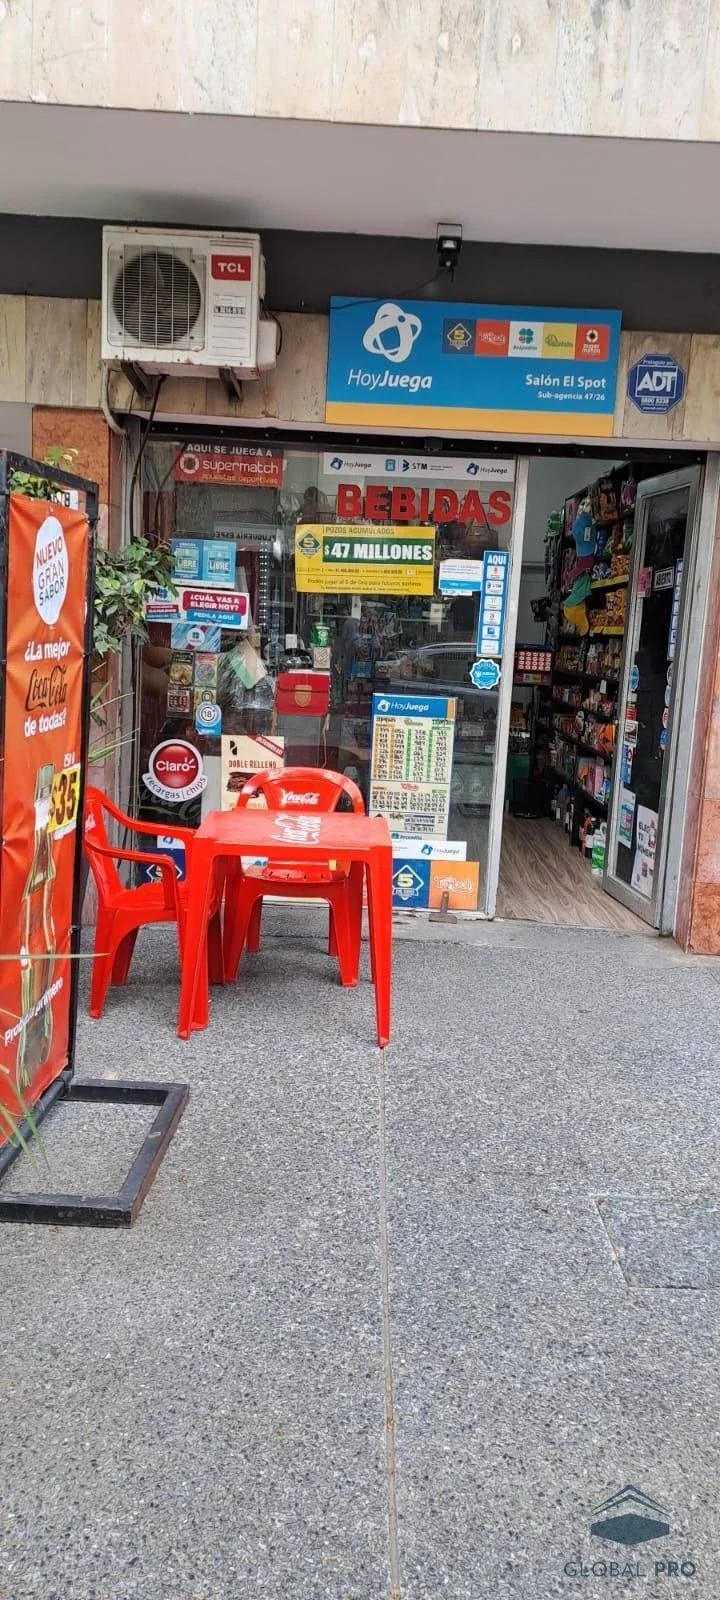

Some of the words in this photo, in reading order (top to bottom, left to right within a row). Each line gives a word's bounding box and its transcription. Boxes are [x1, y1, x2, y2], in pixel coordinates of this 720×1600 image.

[217, 262, 246, 273] TCL
[347, 368, 433, 393] HoyJuega
[525, 374, 560, 387] Salón
[563, 375, 575, 387] El
[577, 376, 606, 390] Spot
[637, 371, 677, 393] ADT
[537, 391, 582, 400] Sub-agencia
[214, 446, 227, 455] SE
[231, 447, 263, 457] JUEGA
[265, 449, 273, 457] A
[202, 459, 279, 474] supermatch
[412, 462, 428, 470] STM
[337, 483, 512, 526] BEBIDAS
[325, 526, 347, 534] POZOS
[348, 527, 395, 535] ACUMULADOS
[36, 535, 62, 568] NUEVO
[324, 545, 330, 555] $
[331, 542, 350, 559] 47
[353, 543, 433, 561] MILLONES
[38, 558, 64, 590] GRAN
[39, 576, 65, 606] SABOR
[24, 641, 43, 662] ¿La
[44, 637, 70, 661] mejor
[391, 702, 429, 712] HoyJuega
[24, 716, 37, 737] de
[38, 707, 67, 733] todas?
[155, 761, 190, 772] Claro
[228, 760, 248, 768] DOBLE
[249, 761, 277, 769] RELLENO
[146, 777, 180, 799] recargas
[186, 777, 206, 796] chips
[397, 873, 413, 888] 5
